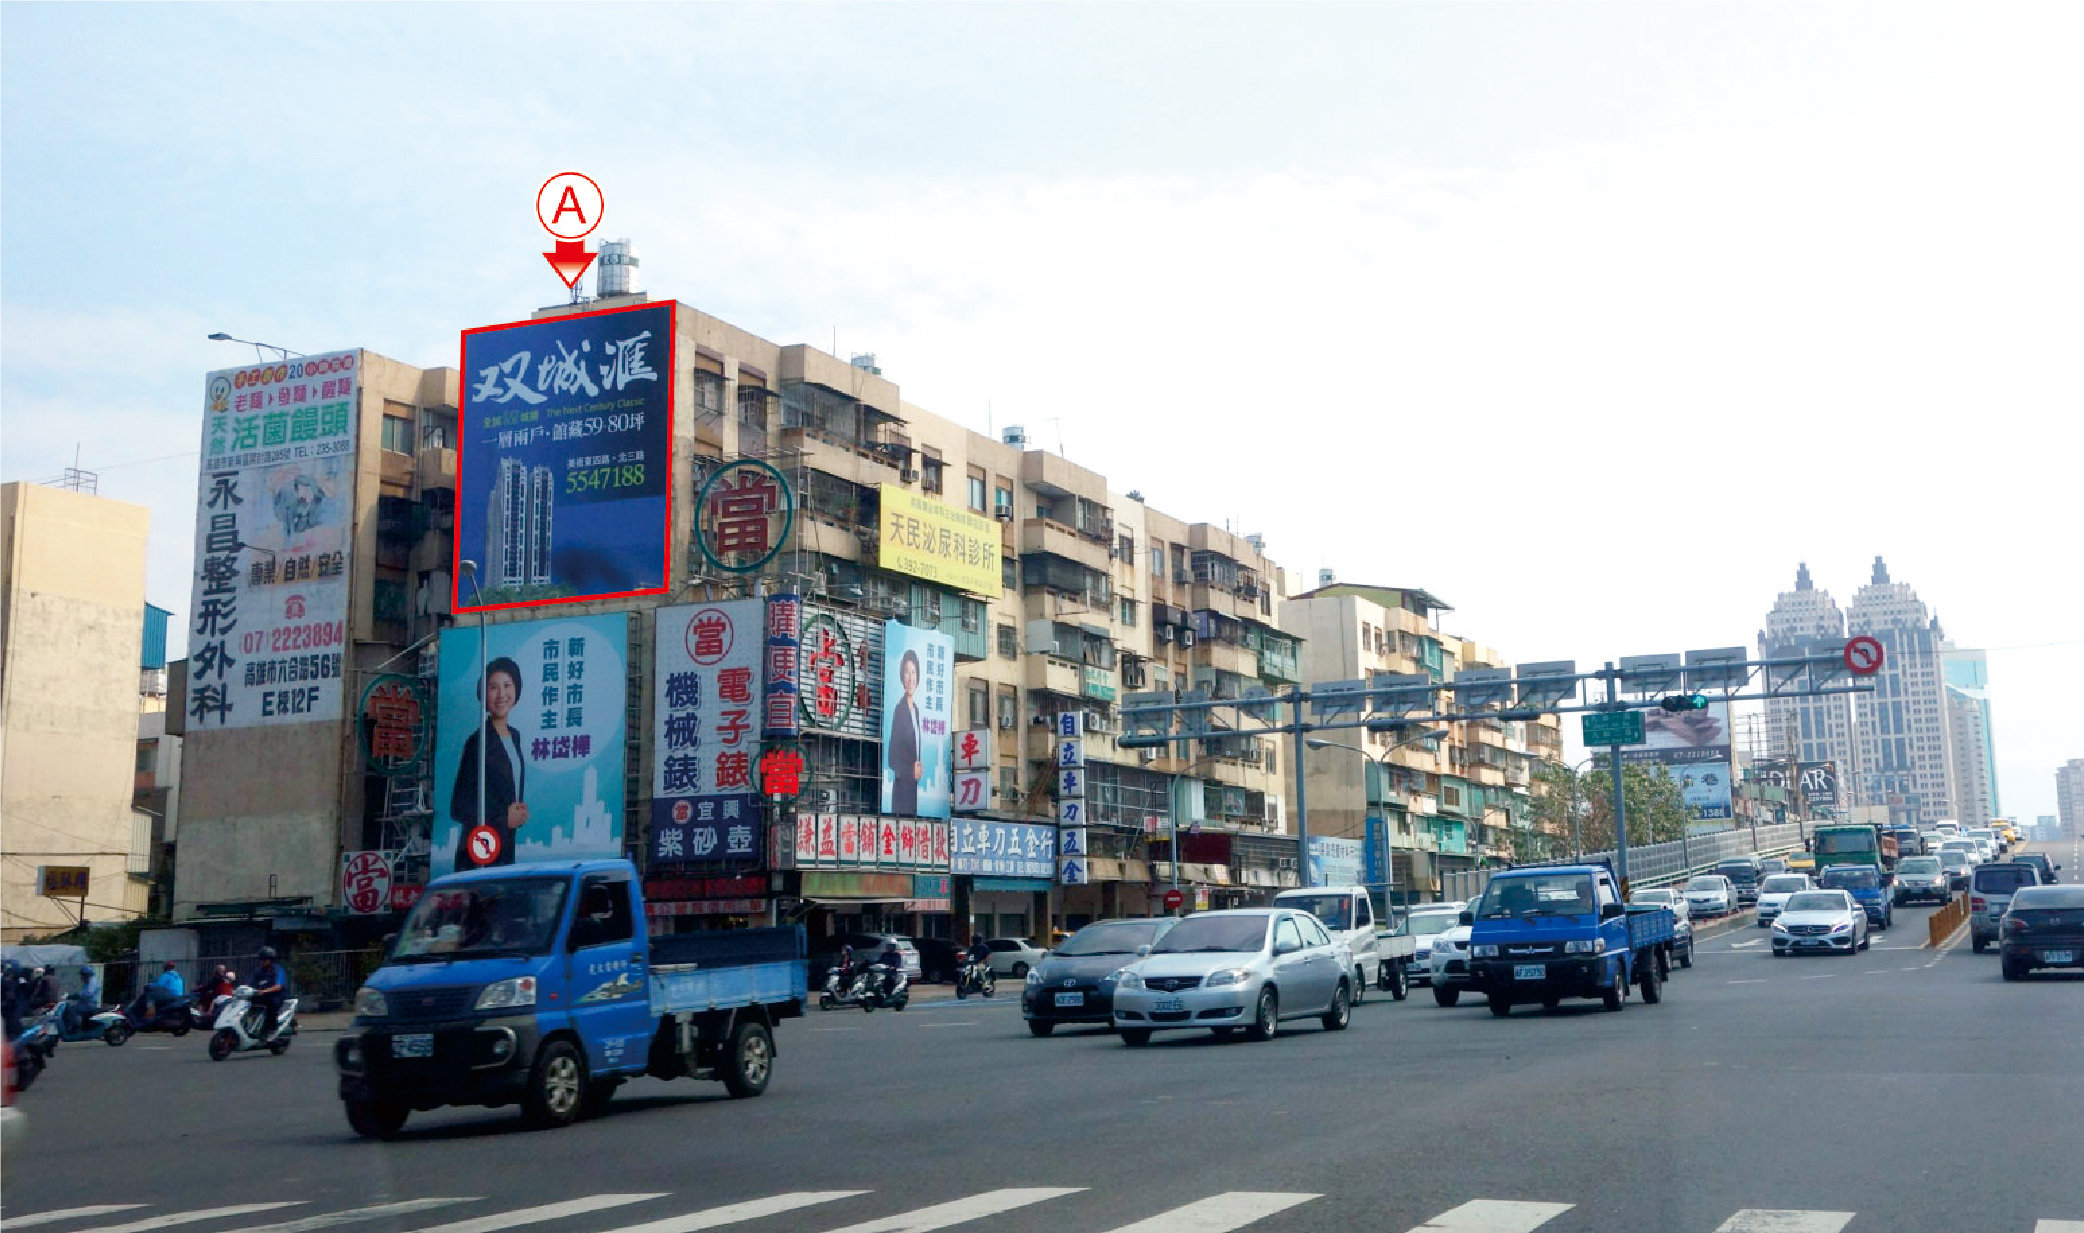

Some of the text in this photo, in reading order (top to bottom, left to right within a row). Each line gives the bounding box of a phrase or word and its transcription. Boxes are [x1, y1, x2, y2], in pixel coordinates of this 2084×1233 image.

[231, 402, 350, 452] 活菌饅頭
[566, 463, 645, 494] 5547188
[711, 474, 776, 556] 當
[891, 511, 995, 572] 天民泌尿科診所
[190, 470, 244, 725] 永昌整形外科
[693, 616, 727, 656] 當
[540, 639, 560, 730] 市民作主
[566, 637, 584, 727] 新好市長
[368, 684, 419, 758] 當
[531, 734, 591, 761] 林岱樺
[663, 671, 699, 790] 機械錶
[715, 667, 752, 788] 電子錶
[760, 749, 803, 794] 當
[960, 733, 981, 805] 車刀
[1060, 713, 1082, 883] 自立車刀五金
[346, 853, 388, 912] 當
